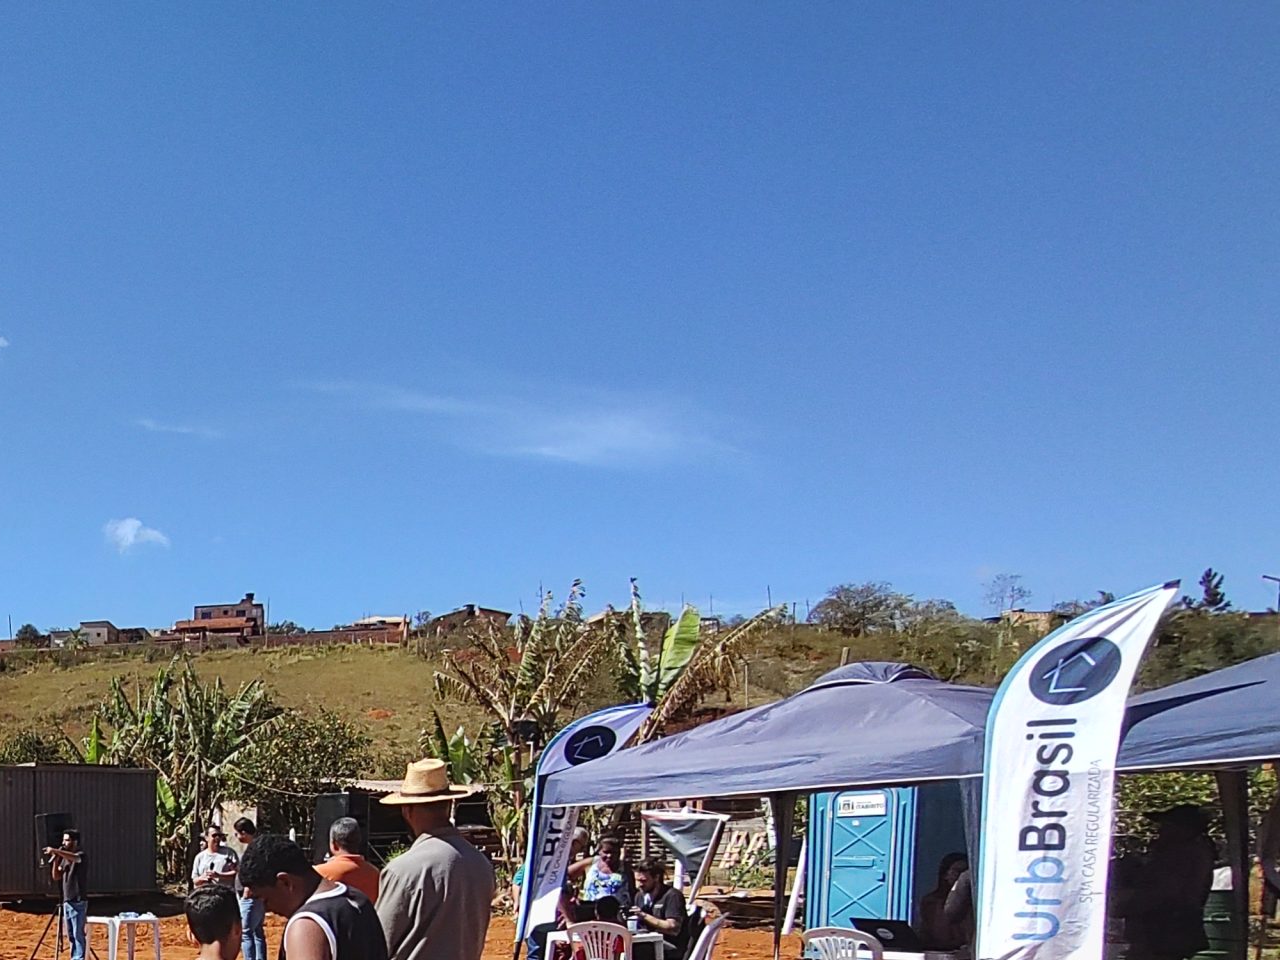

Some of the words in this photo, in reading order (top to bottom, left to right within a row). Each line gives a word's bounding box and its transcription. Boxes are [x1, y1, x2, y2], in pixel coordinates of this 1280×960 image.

[1011, 718, 1077, 941] UrbBrasil
[1084, 758, 1103, 846] REGULARIZADA
[1079, 880, 1094, 903] SUA
[1081, 848, 1097, 878] CASA
